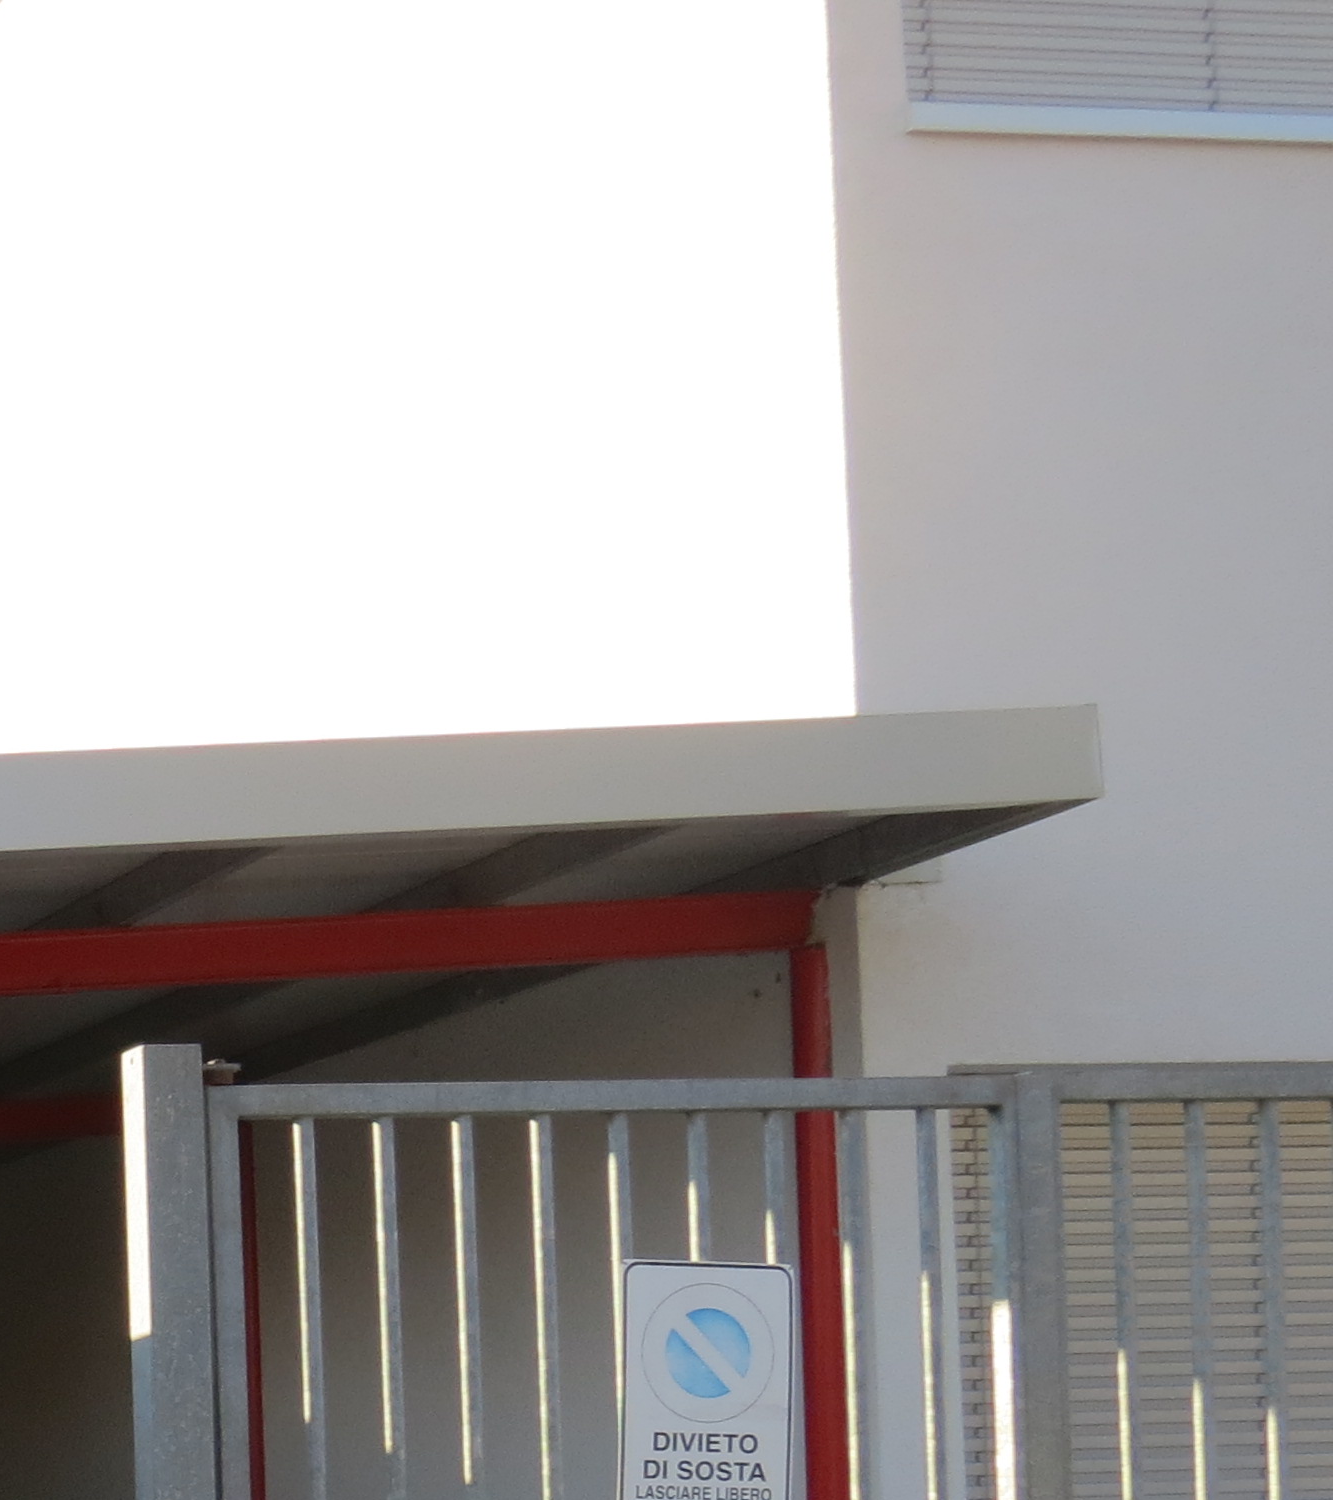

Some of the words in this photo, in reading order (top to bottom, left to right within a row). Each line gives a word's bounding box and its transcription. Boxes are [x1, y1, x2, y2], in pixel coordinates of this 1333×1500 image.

[652, 1431, 758, 1454] DIVIETO
[643, 1459, 668, 1479] DI
[676, 1460, 767, 1482] SOSTA
[635, 1485, 712, 1500] LASCIARE
